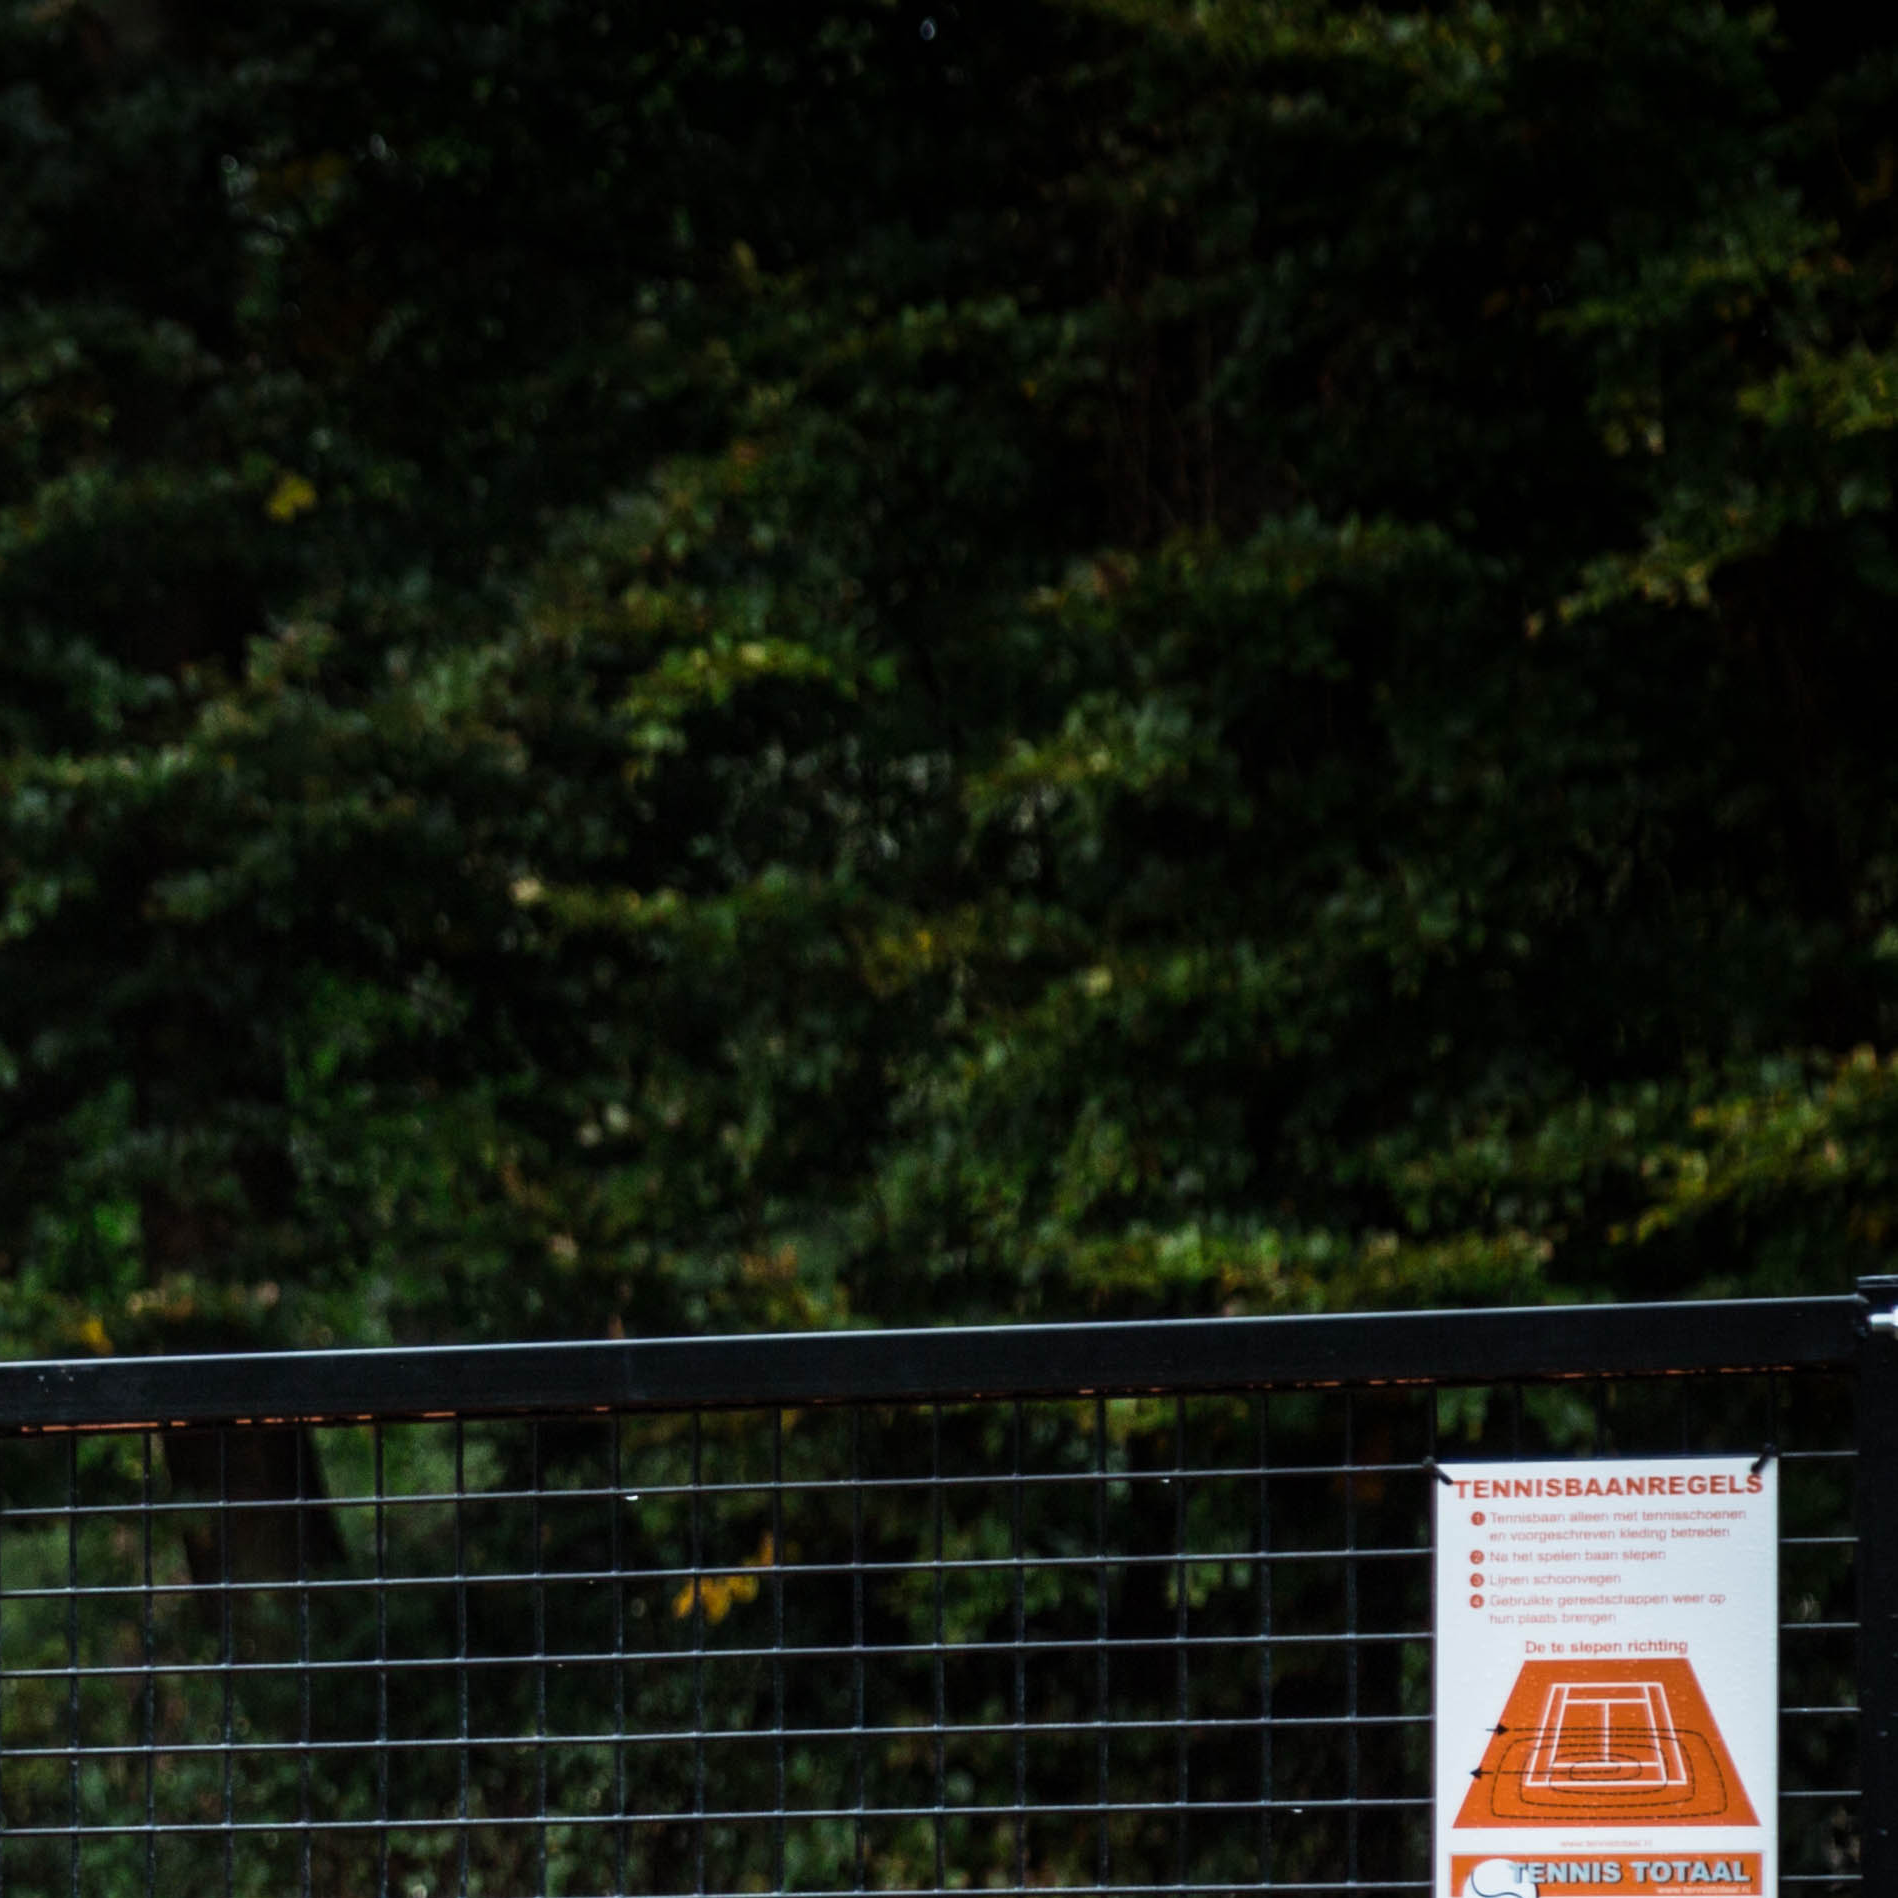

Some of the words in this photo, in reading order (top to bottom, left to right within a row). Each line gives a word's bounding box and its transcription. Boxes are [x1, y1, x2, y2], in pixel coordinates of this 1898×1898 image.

[1453, 1474, 1764, 1499] TENNISBAANREGELS
[1490, 1511, 1565, 1524] Tennisbaan
[1569, 1511, 1609, 1522] alleen
[1613, 1510, 1638, 1521] met
[1642, 1509, 1747, 1521] tennisschoenen
[1489, 1532, 1506, 1542] en
[1619, 1528, 1667, 1541] kleding
[1671, 1527, 1730, 1539] betreden
[1490, 1551, 1508, 1562] Na
[1512, 1551, 1533, 1562] het
[1537, 1551, 1581, 1564] spelen
[1585, 1550, 1618, 1561] baan
[1622, 1549, 1666, 1562] slepen
[1490, 1575, 1529, 1588] Lijnen
[1533, 1573, 1622, 1587] schoonvegen
[1490, 1594, 1553, 1607] Gebruikte
[1672, 1593, 1705, 1604] weer
[1708, 1593, 1726, 1605] op
[1490, 1613, 1514, 1625] hun
[1518, 1612, 1557, 1625] plaats
[1561, 1612, 1617, 1625] brengen
[1525, 1640, 1547, 1654] De
[1551, 1641, 1565, 1654] te
[1570, 1640, 1623, 1655] slepen
[1627, 1639, 1689, 1655] richting
[1509, 1861, 1623, 1884] TENNIS
[1629, 1860, 1752, 1884] TOTAAL
